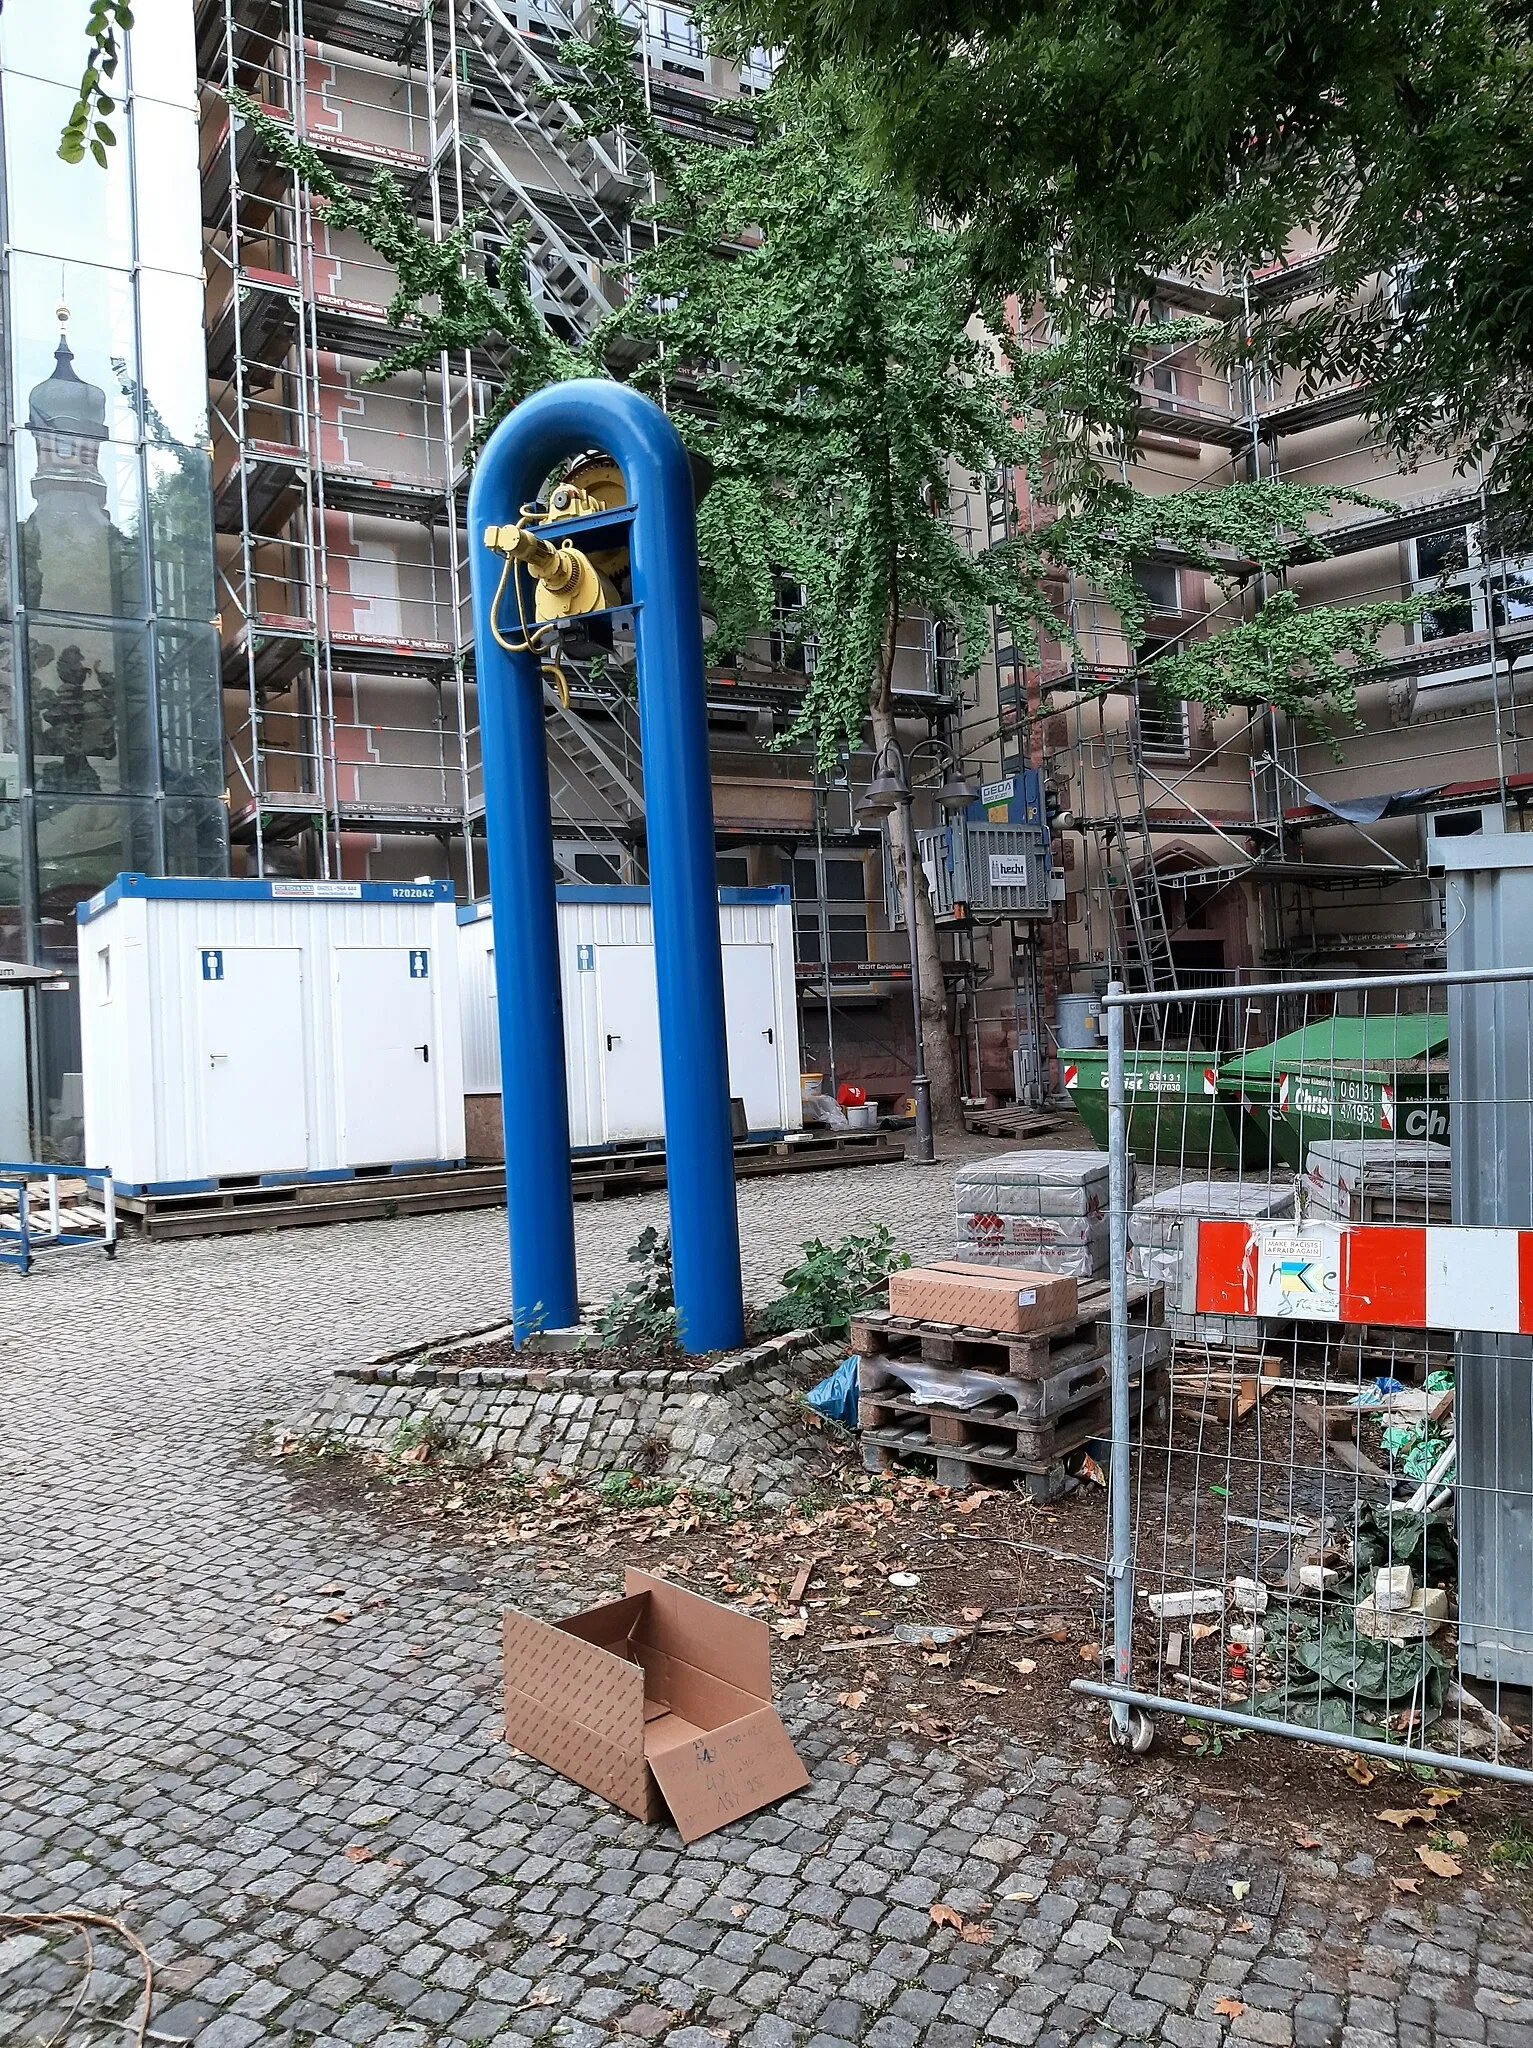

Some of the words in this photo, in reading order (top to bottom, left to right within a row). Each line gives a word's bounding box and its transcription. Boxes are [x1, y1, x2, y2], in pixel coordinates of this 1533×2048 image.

[309, 131, 335, 143] HECHT
[318, 294, 345, 306] HECHT
[332, 633, 358, 641] HECHT
[983, 781, 1012, 796] GEDA
[1000, 863, 1024, 875] hecht
[392, 888, 435, 898] R202042
[1101, 1077, 1143, 1090] Cist
